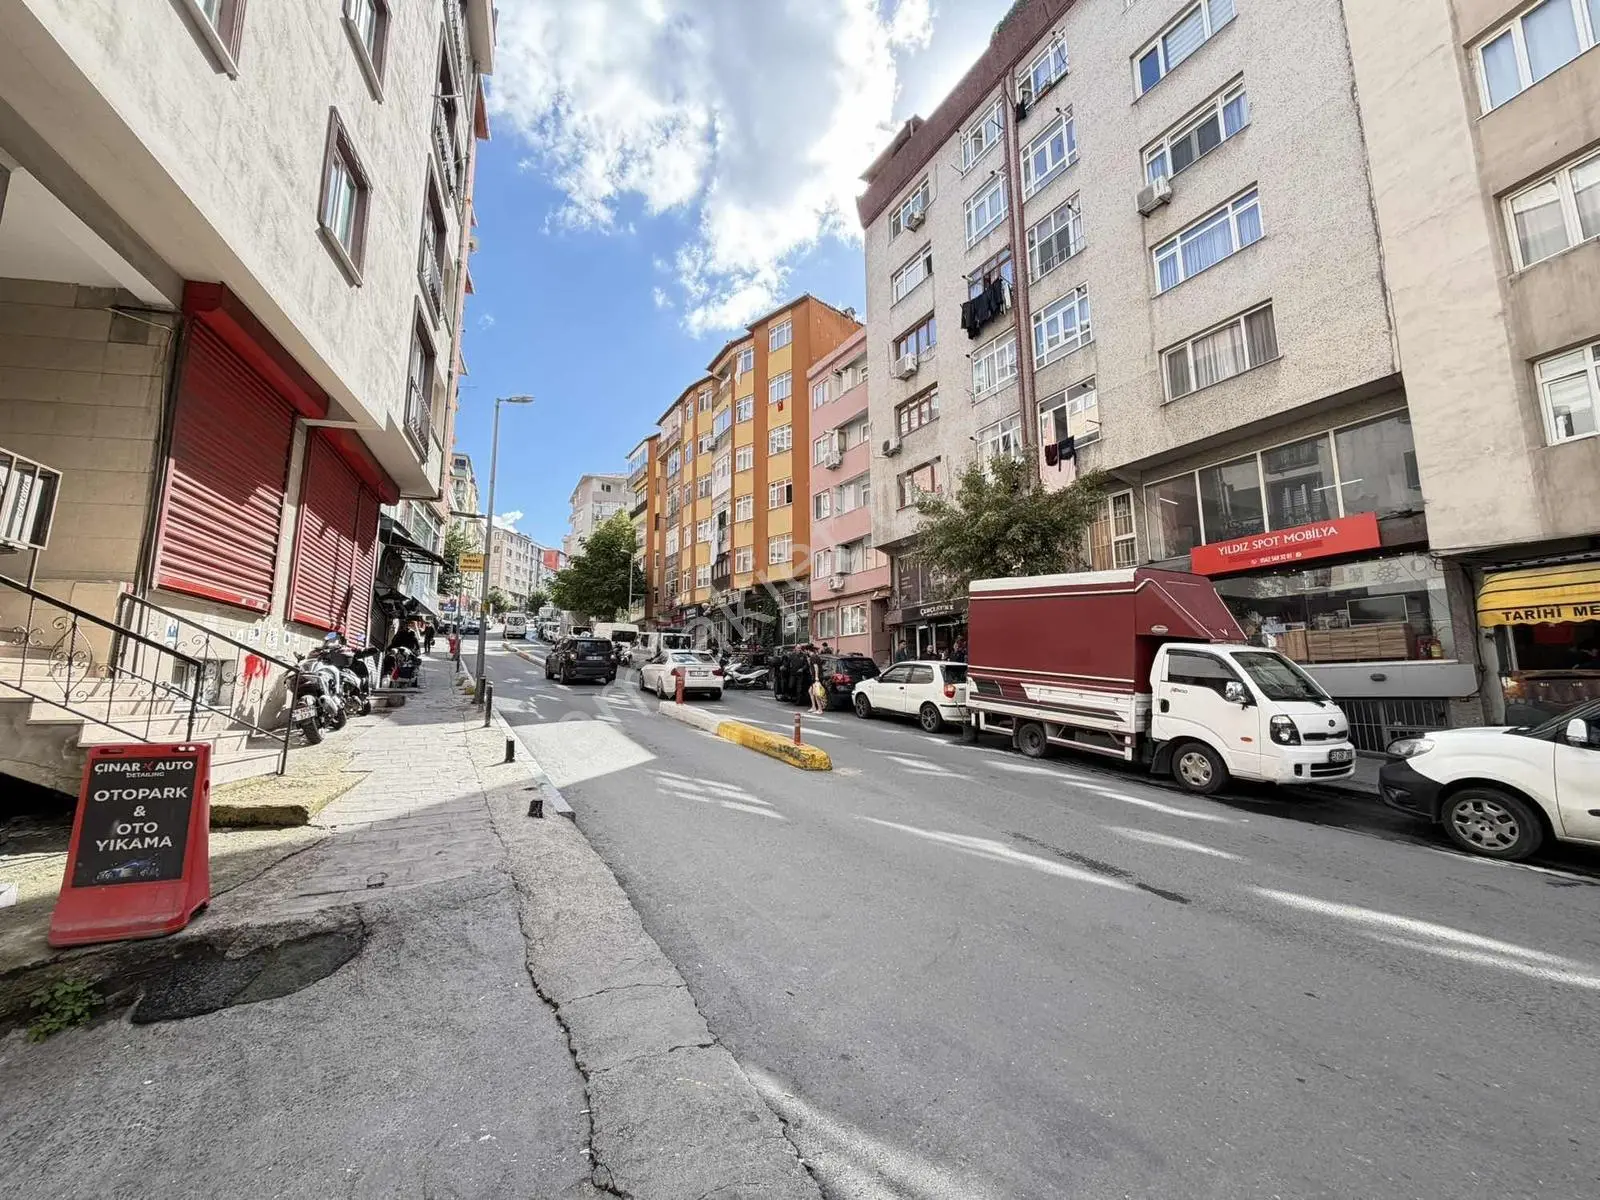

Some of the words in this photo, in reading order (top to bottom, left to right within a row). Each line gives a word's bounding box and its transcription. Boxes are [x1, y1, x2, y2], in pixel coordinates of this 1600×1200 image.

[1218, 542, 1249, 555] YILDIZ
[1252, 536, 1280, 549] SPOT
[1284, 526, 1338, 544] MOBİLYA
[1502, 605, 1562, 621] TARİHİ
[94, 762, 140, 775] ÇINAR
[155, 761, 193, 771] AUTO
[94, 787, 188, 802] OTOPARK
[133, 805, 146, 817] &
[116, 822, 158, 835] OTO
[96, 836, 172, 852] YIKAMA
